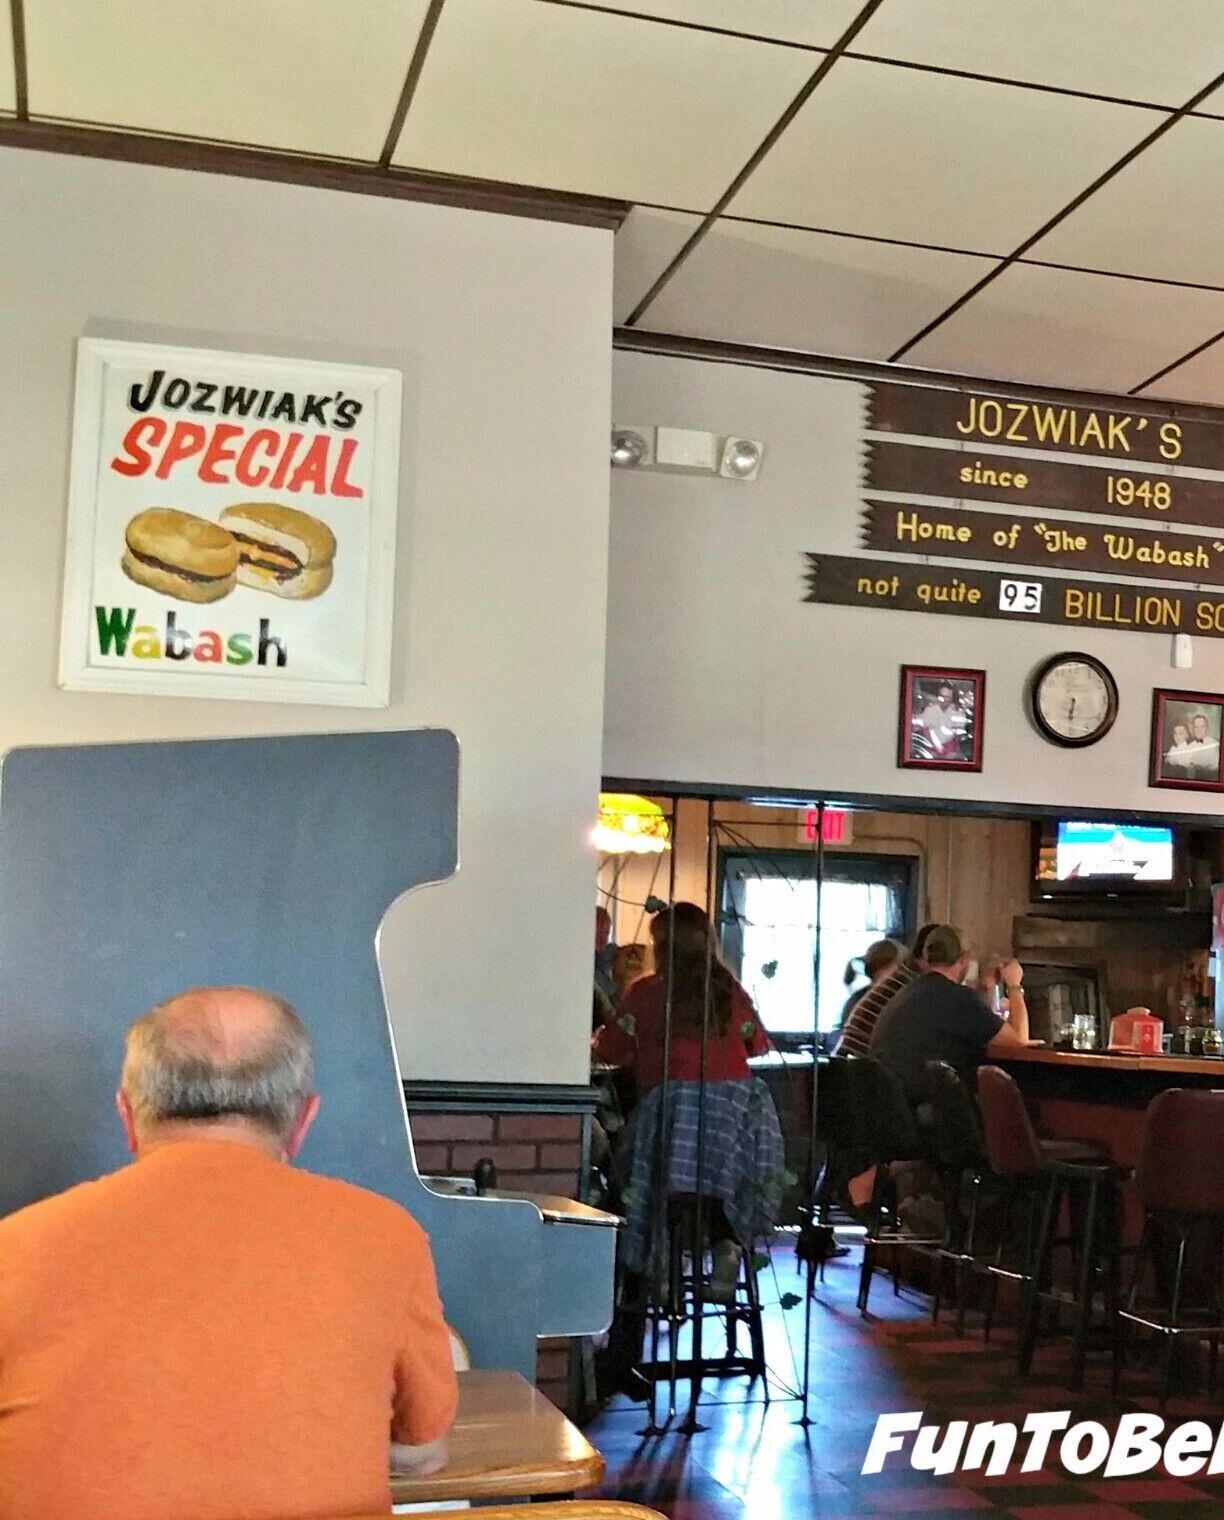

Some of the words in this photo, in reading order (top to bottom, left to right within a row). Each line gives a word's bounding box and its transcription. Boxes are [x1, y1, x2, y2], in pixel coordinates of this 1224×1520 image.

[127, 370, 362, 429] JOZWIAK'S
[956, 399, 1183, 459] JOZWIAK'S
[110, 416, 364, 499] SPECIAL
[960, 461, 1029, 488] since
[1107, 476, 1171, 510] 1948
[897, 511, 971, 543] Home
[993, 524, 1021, 549] of
[857, 576, 899, 596] not
[917, 578, 981, 604] quite
[1004, 583, 1038, 611] 95
[1065, 589, 1181, 626] BILLION
[95, 605, 288, 668] Wabash
